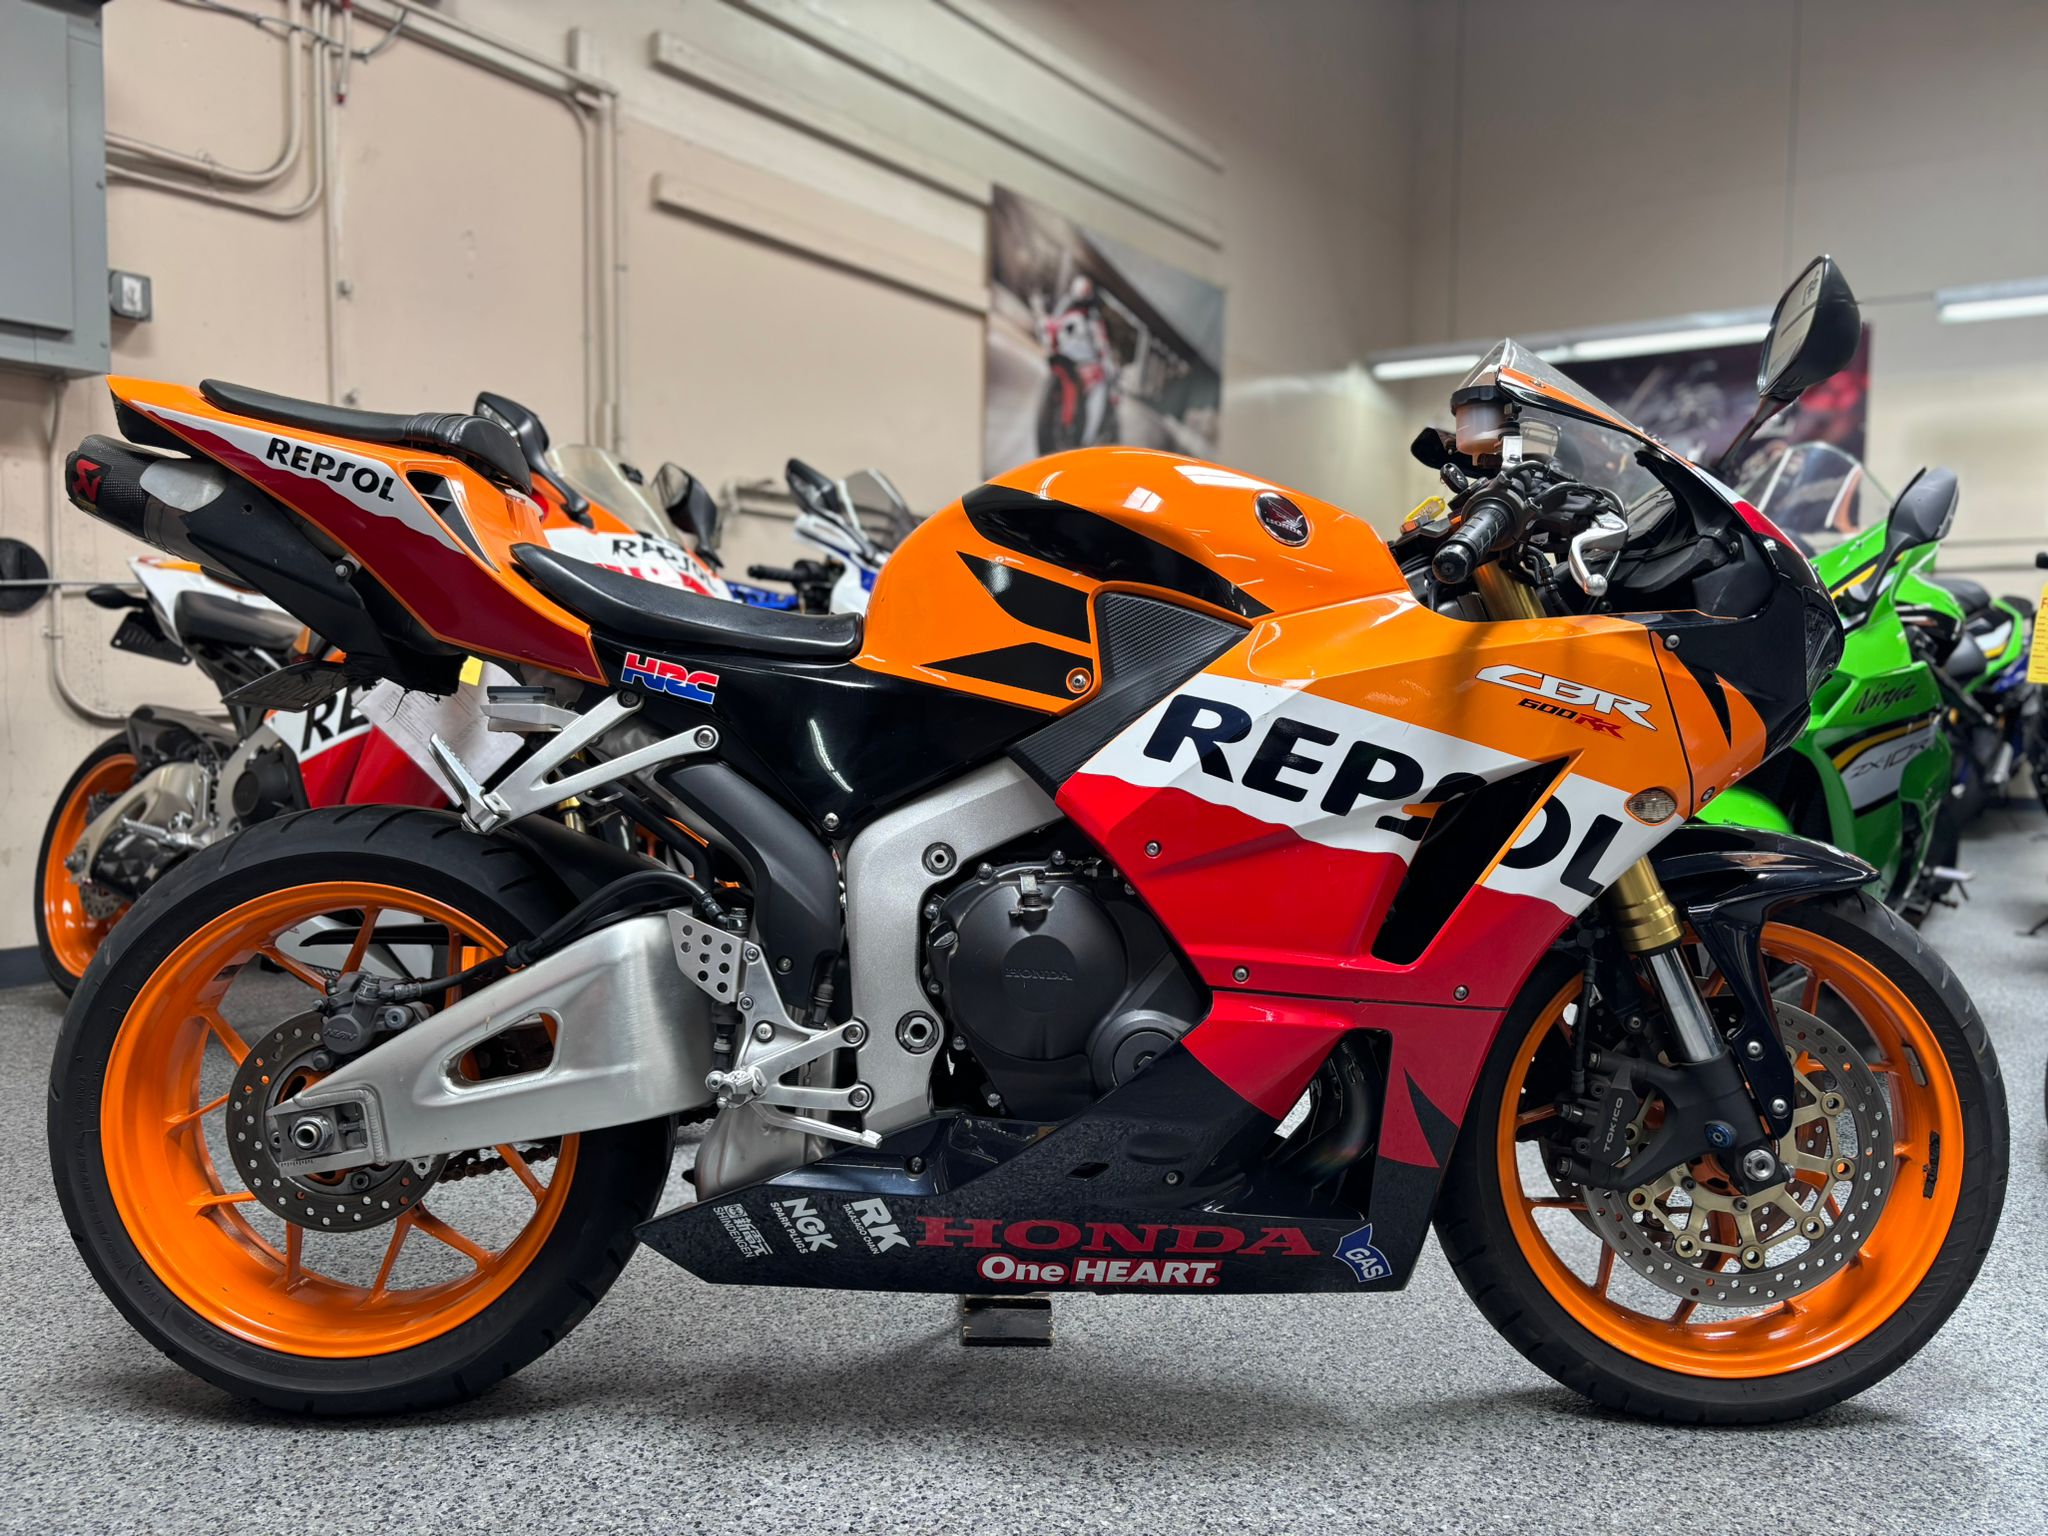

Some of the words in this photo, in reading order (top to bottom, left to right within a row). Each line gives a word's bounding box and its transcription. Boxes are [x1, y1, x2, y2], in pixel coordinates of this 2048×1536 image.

[266, 437, 395, 502] REPSOL
[620, 651, 720, 705] HRC
[1475, 664, 1657, 731] CBR
[1852, 679, 1917, 715] Ninja
[1518, 697, 1626, 741] 600RR
[1005, 967, 1073, 981] HONDA
[1603, 1097, 1624, 1153] TOKICO
[713, 1206, 755, 1258] SHINDENGEN
[770, 1202, 792, 1233] SPARK
[786, 1229, 809, 1255] PLUGS
[782, 1197, 838, 1252] NGK
[842, 1203, 866, 1237] TAKASAGO
[862, 1234, 881, 1255] CHAIN
[851, 1197, 911, 1253] RK
[915, 1215, 1320, 1256] HONDA
[982, 1256, 1065, 1282] One
[1077, 1261, 1216, 1285] HEART.
[1344, 1246, 1385, 1281] GAS
